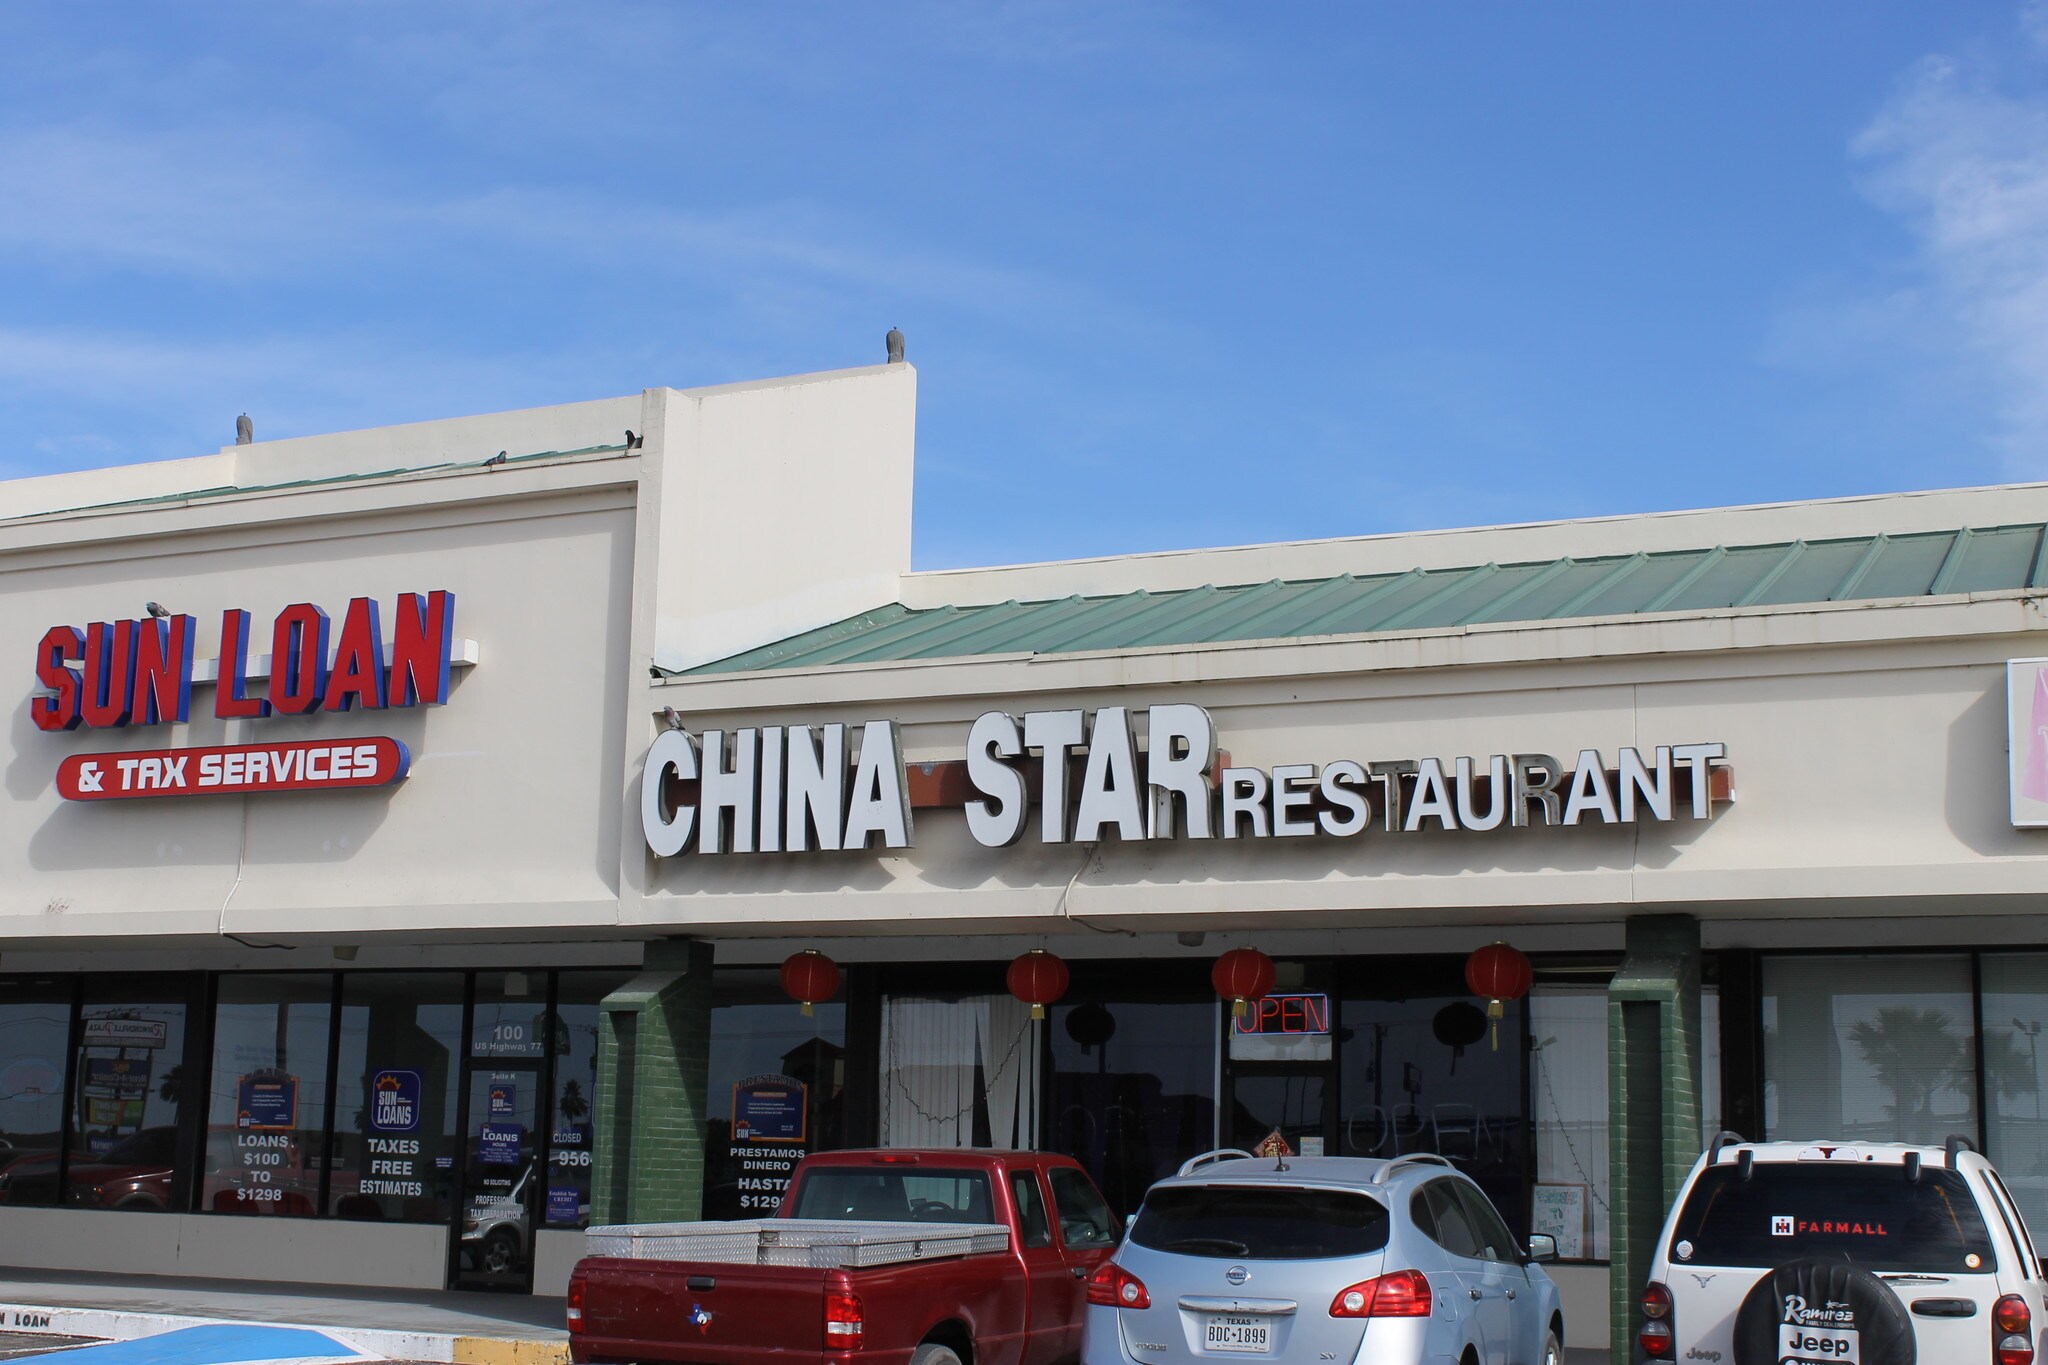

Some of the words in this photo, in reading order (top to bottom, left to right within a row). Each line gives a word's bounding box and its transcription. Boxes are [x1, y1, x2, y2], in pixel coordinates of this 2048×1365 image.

[31, 614, 196, 731] SUN
[215, 590, 455, 720] LOAN
[78, 762, 104, 793] &
[117, 756, 188, 790] TAX
[199, 745, 378, 786] SERVICES
[641, 720, 912, 858] CHINA
[964, 703, 1218, 847] STAR
[1222, 742, 1727, 839] RESTAURANT
[1236, 997, 1327, 1033] OPEN
[494, 1025, 523, 1041] 100
[475, 1042, 487, 1051] US
[489, 1042, 527, 1052] Highway
[530, 1042, 542, 1051] 77
[378, 1091, 397, 1105] SUN
[377, 1106, 412, 1125] LOANS
[238, 1135, 289, 1148] LOANS
[482, 1132, 518, 1142] LOANS
[553, 1132, 582, 1143] CLOSED
[368, 1138, 419, 1154] TAXES
[730, 1147, 805, 1158] PRESTAMOS
[244, 1153, 280, 1166] $100
[743, 1160, 791, 1171] DINERO
[371, 1160, 412, 1175] FREE
[251, 1170, 271, 1182] TO
[237, 1188, 282, 1201] $1298
[360, 1179, 422, 1196] ESTIMATES
[475, 1195, 517, 1205] PROFESSIONAL
[740, 1194, 784, 1209] $129
[470, 1208, 481, 1218] TAX
[1799, 1220, 1887, 1235] FARMALL
[1784, 1294, 1854, 1324] Ramirez
[15, 1313, 49, 1327] LOAN
[1789, 1333, 1850, 1357] Jeep
[1686, 1347, 1722, 1363] Jeep
